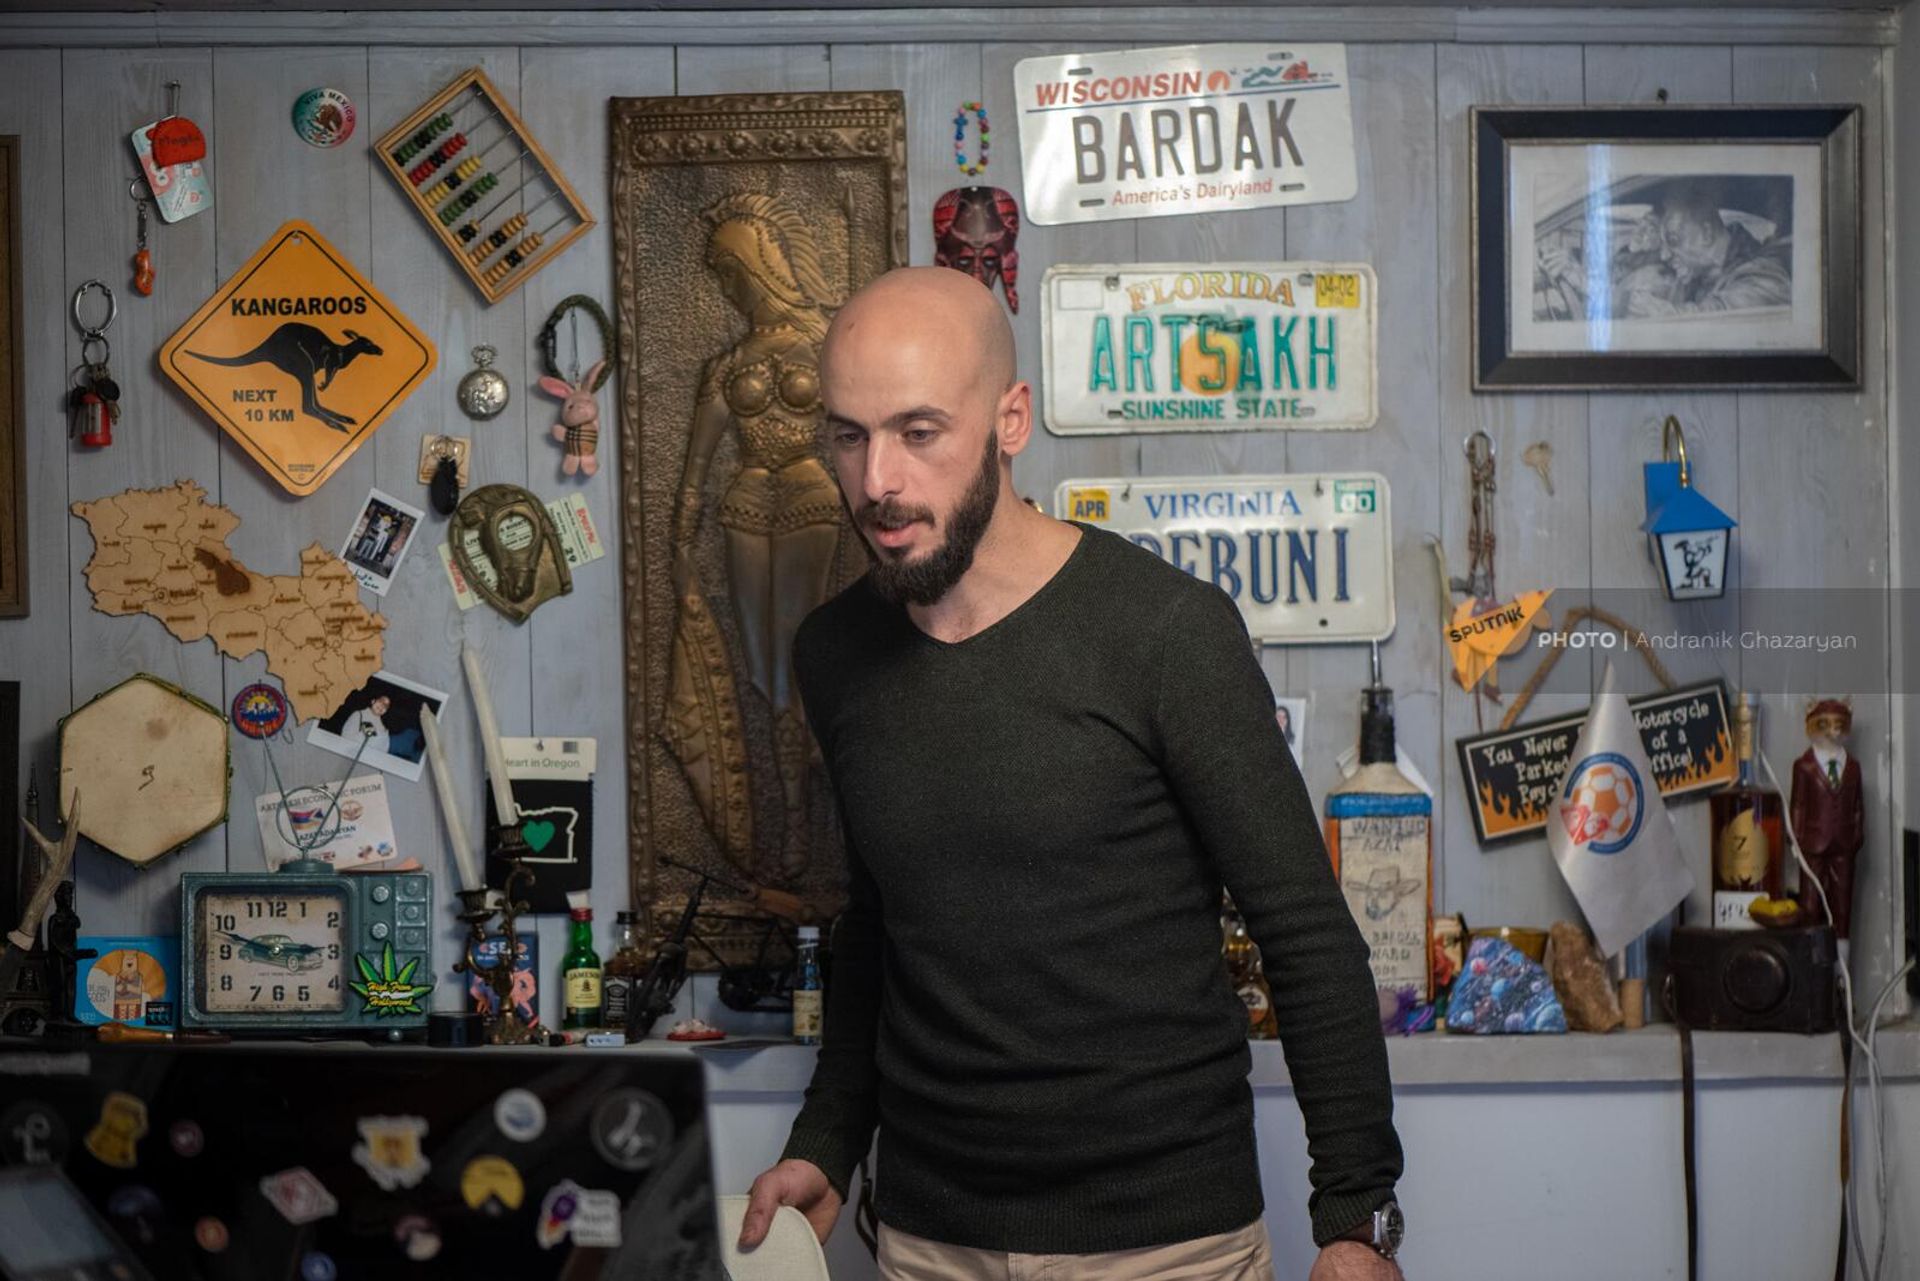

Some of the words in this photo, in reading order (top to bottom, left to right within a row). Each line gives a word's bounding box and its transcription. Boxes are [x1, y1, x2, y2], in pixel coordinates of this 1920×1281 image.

[1035, 71, 1201, 106] WISCONSIN
[304, 91, 325, 104] VIVA
[328, 92, 353, 122] MEXICO
[1072, 98, 1305, 184] BARDAK
[1112, 184, 1191, 206] America's
[1197, 178, 1273, 203] Dairyland
[1125, 271, 1296, 311] FLORIDA
[231, 296, 367, 317] KANGAROOS
[1089, 314, 1337, 392] ARTSAKH
[233, 389, 277, 402] NEXT
[244, 408, 263, 422] 10
[269, 409, 294, 422] KM
[1122, 399, 1225, 420] SUNSHINE
[1236, 398, 1302, 419] STATE
[1075, 500, 1105, 518] APR
[1143, 489, 1302, 520] VIRGINIA
[1129, 527, 1351, 605] EBUNI
[1449, 605, 1525, 643] SPUTNIK
[1652, 729, 1668, 750] of
[1483, 744, 1514, 767] You
[1523, 734, 1568, 756] Never
[531, 758, 540, 768] in
[541, 757, 580, 770] Oregon
[1652, 745, 1693, 773] ffice!
[350, 783, 382, 796] FORUM
[247, 902, 262, 918] 11
[269, 902, 287, 918] 12
[299, 902, 307, 918] 1
[215, 914, 236, 931] 10
[327, 912, 339, 928] 2
[219, 945, 232, 960] 9
[328, 944, 340, 960] 3
[221, 975, 233, 991] 8
[327, 975, 340, 990] 4
[367, 982, 389, 993] High
[390, 981, 412, 992] From
[250, 986, 261, 1001] 7
[272, 985, 285, 1001] 6
[297, 986, 310, 1001] 5
[369, 995, 413, 1007] Hollywood
